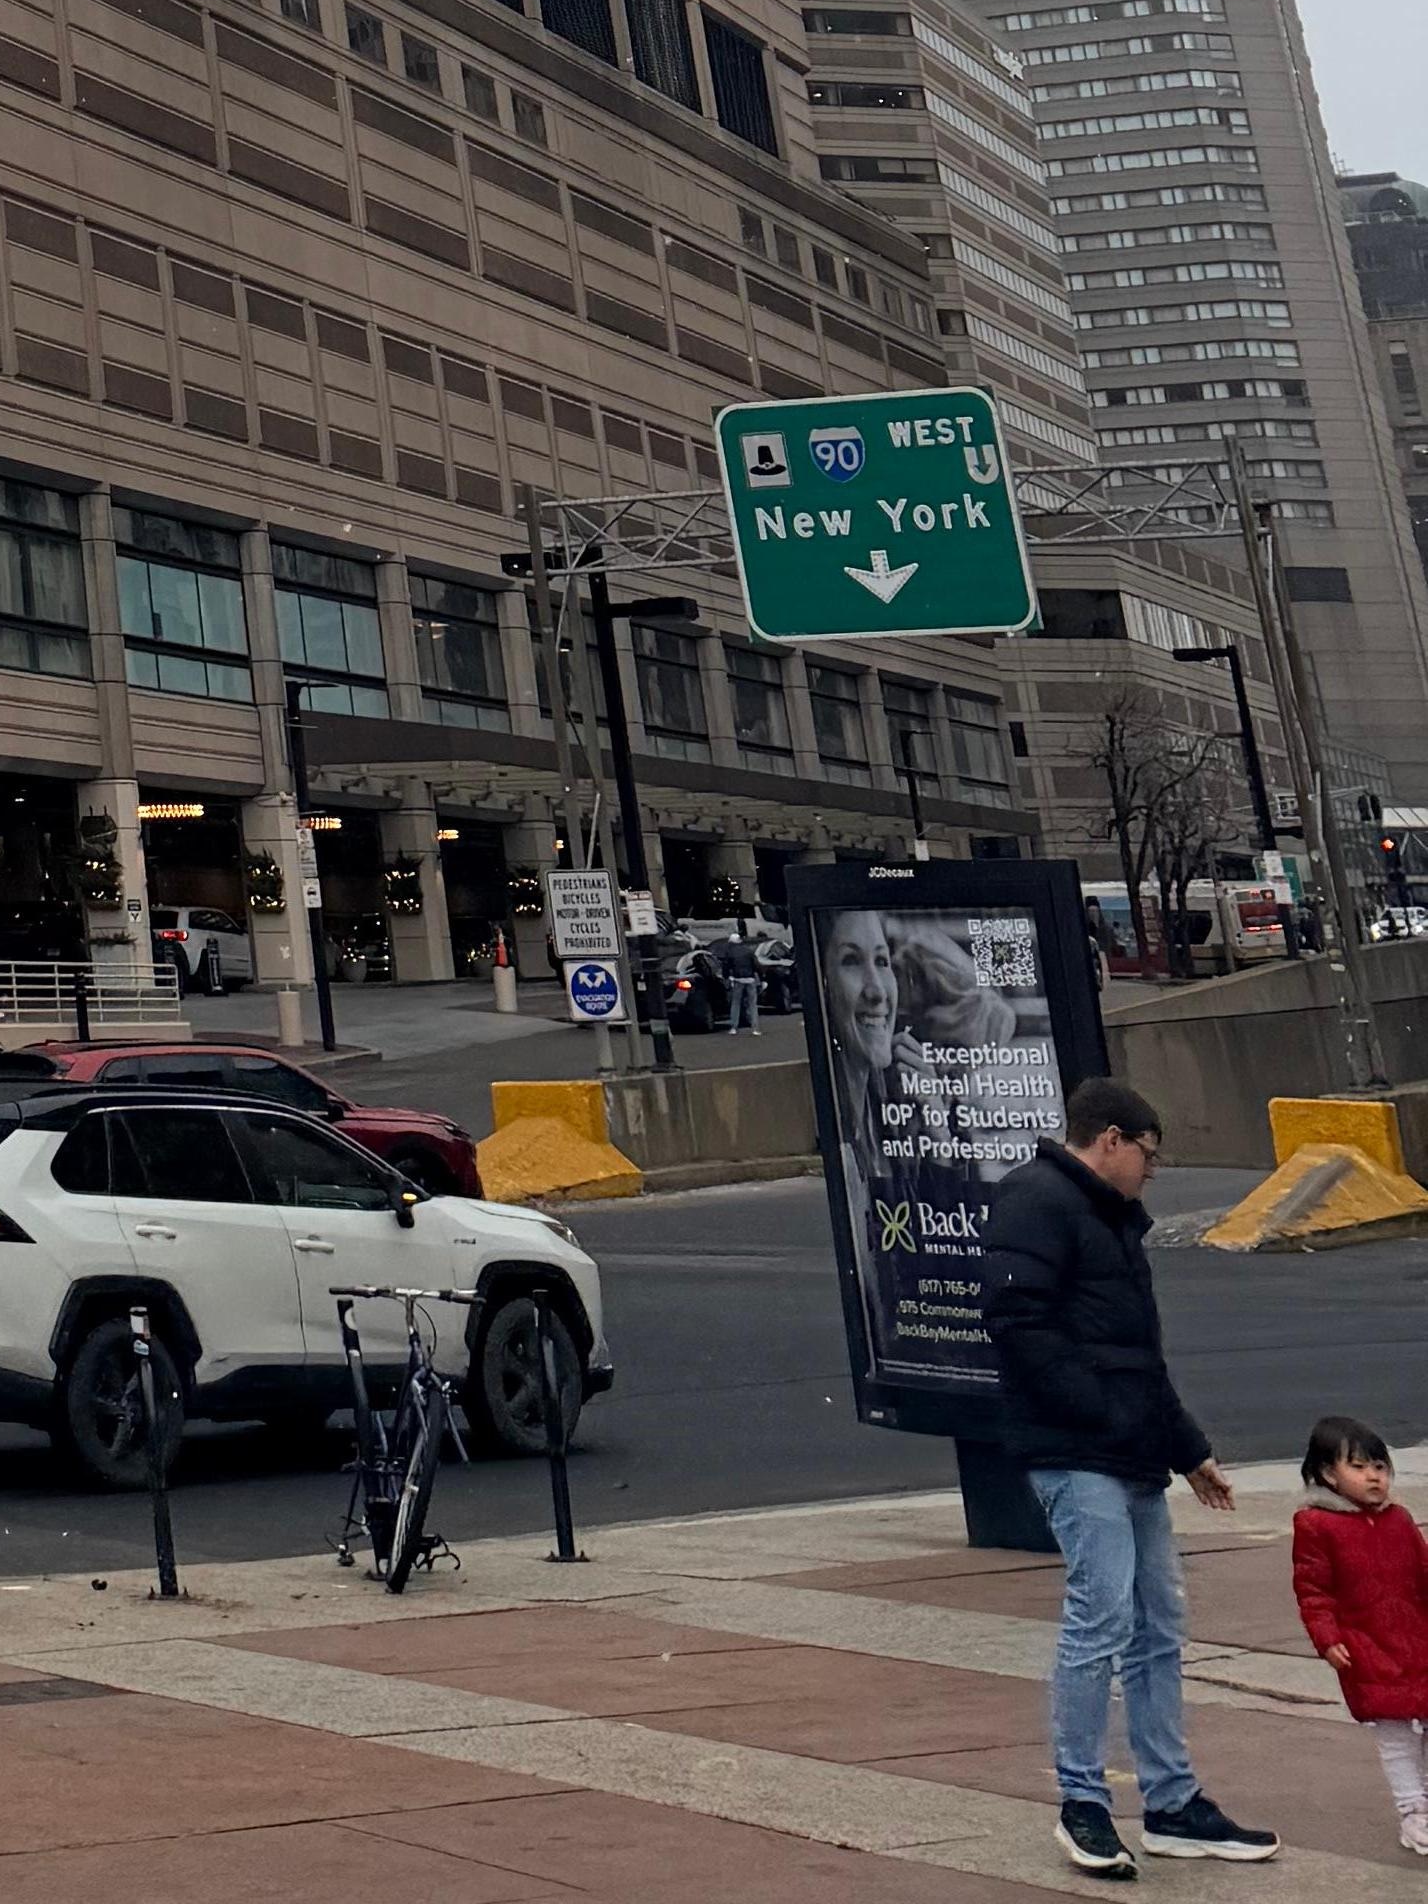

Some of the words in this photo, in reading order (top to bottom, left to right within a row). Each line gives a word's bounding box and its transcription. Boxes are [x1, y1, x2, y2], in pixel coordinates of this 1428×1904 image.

[887, 416, 973, 448] WEST
[816, 441, 859, 472] 90
[755, 506, 852, 540] New
[876, 493, 991, 533] York
[552, 878, 608, 890] PEDESTRIANS
[562, 893, 601, 904] BICYCLES
[570, 922, 601, 934] CYCLES
[564, 936, 612, 949] PROHIBITED
[922, 1042, 1049, 1068] Exceptional
[901, 1072, 969, 1095] Mental
[976, 1073, 1055, 1096] Health
[923, 1103, 950, 1126] for
[956, 1104, 1061, 1129] Students
[882, 1136, 914, 1158] and
[917, 1202, 980, 1238] Back
[924, 1244, 965, 1256] MENTAL
[967, 1245, 986, 1257] HE
[918, 1279, 943, 1296] (617)
